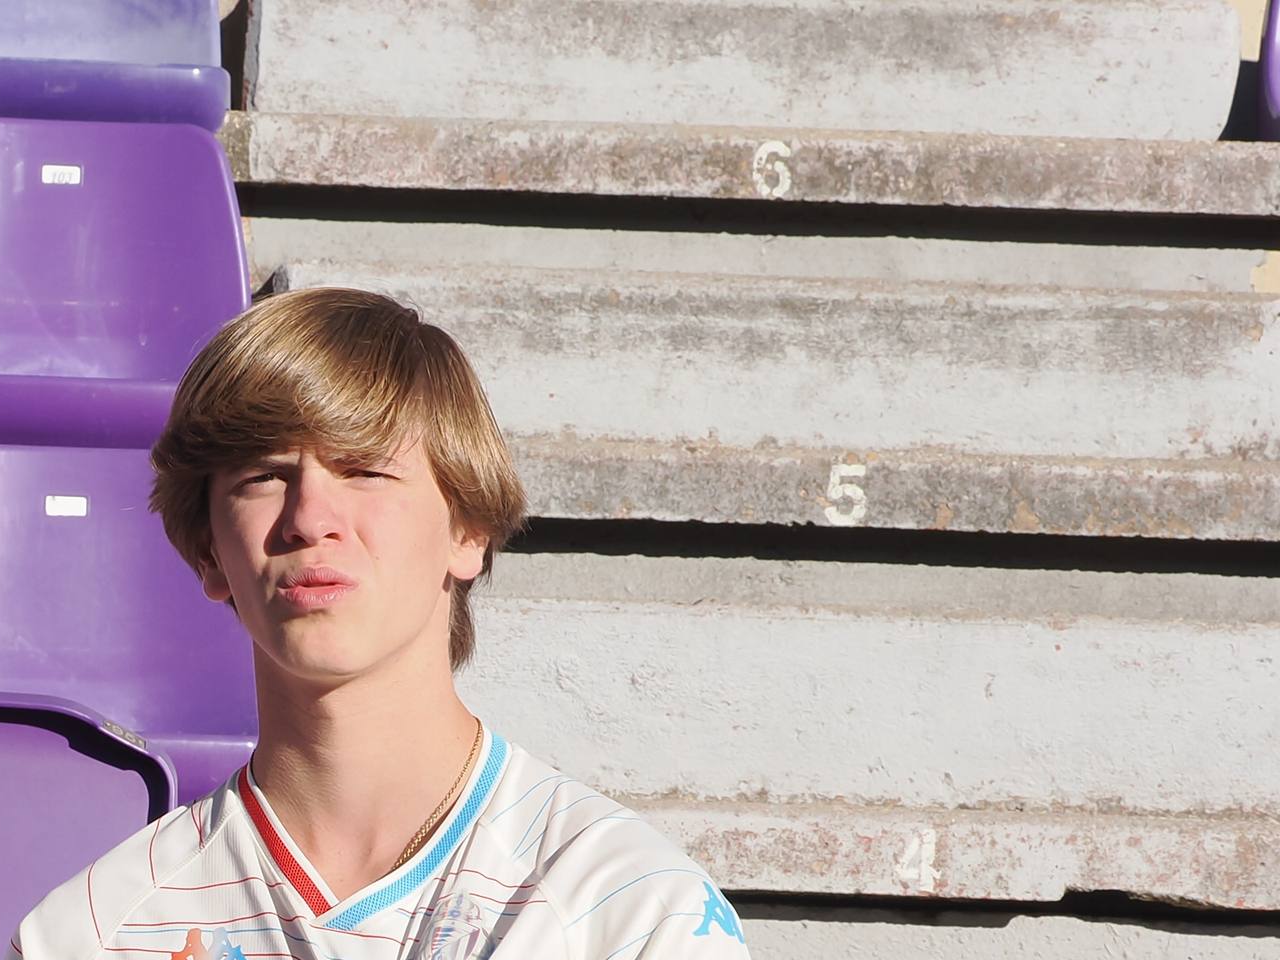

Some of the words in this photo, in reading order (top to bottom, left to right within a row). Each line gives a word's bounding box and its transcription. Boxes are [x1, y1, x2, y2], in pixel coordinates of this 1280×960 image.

[752, 140, 792, 199] 6
[824, 463, 867, 526] 5
[896, 828, 942, 893] 4
